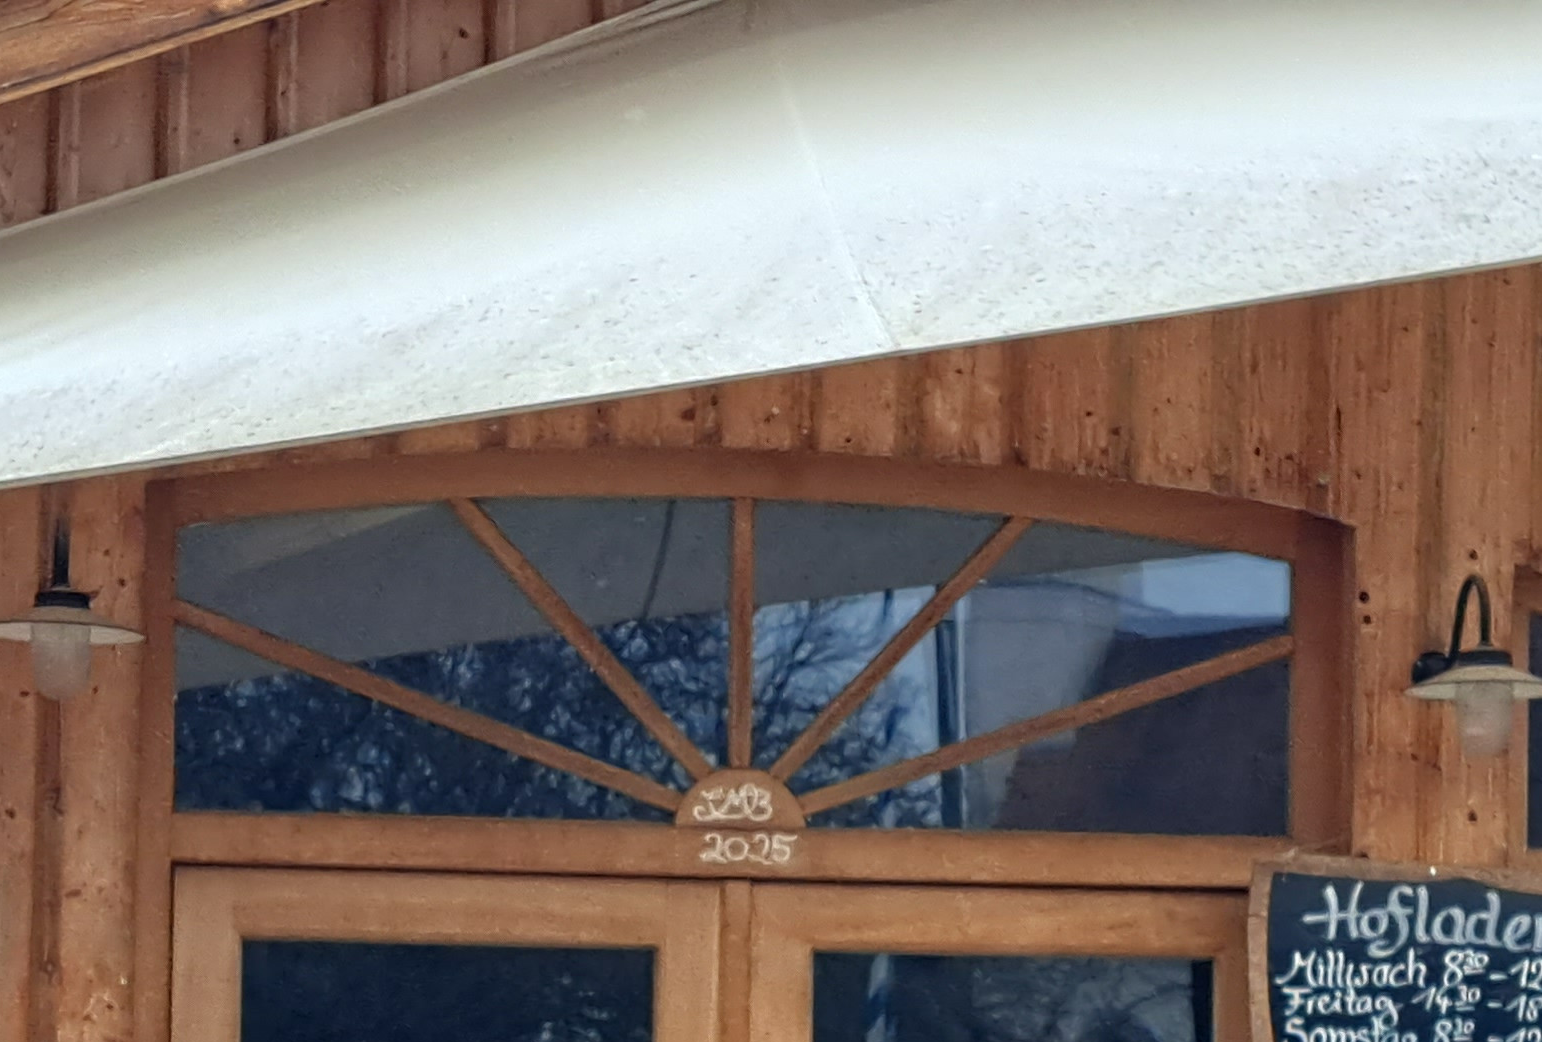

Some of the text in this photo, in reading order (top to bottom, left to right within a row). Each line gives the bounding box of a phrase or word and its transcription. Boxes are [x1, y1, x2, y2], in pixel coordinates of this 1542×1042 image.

[699, 832, 798, 865] 2025
[1274, 947, 1427, 988] Mittwoch
[1281, 986, 1404, 1030] Freitag
